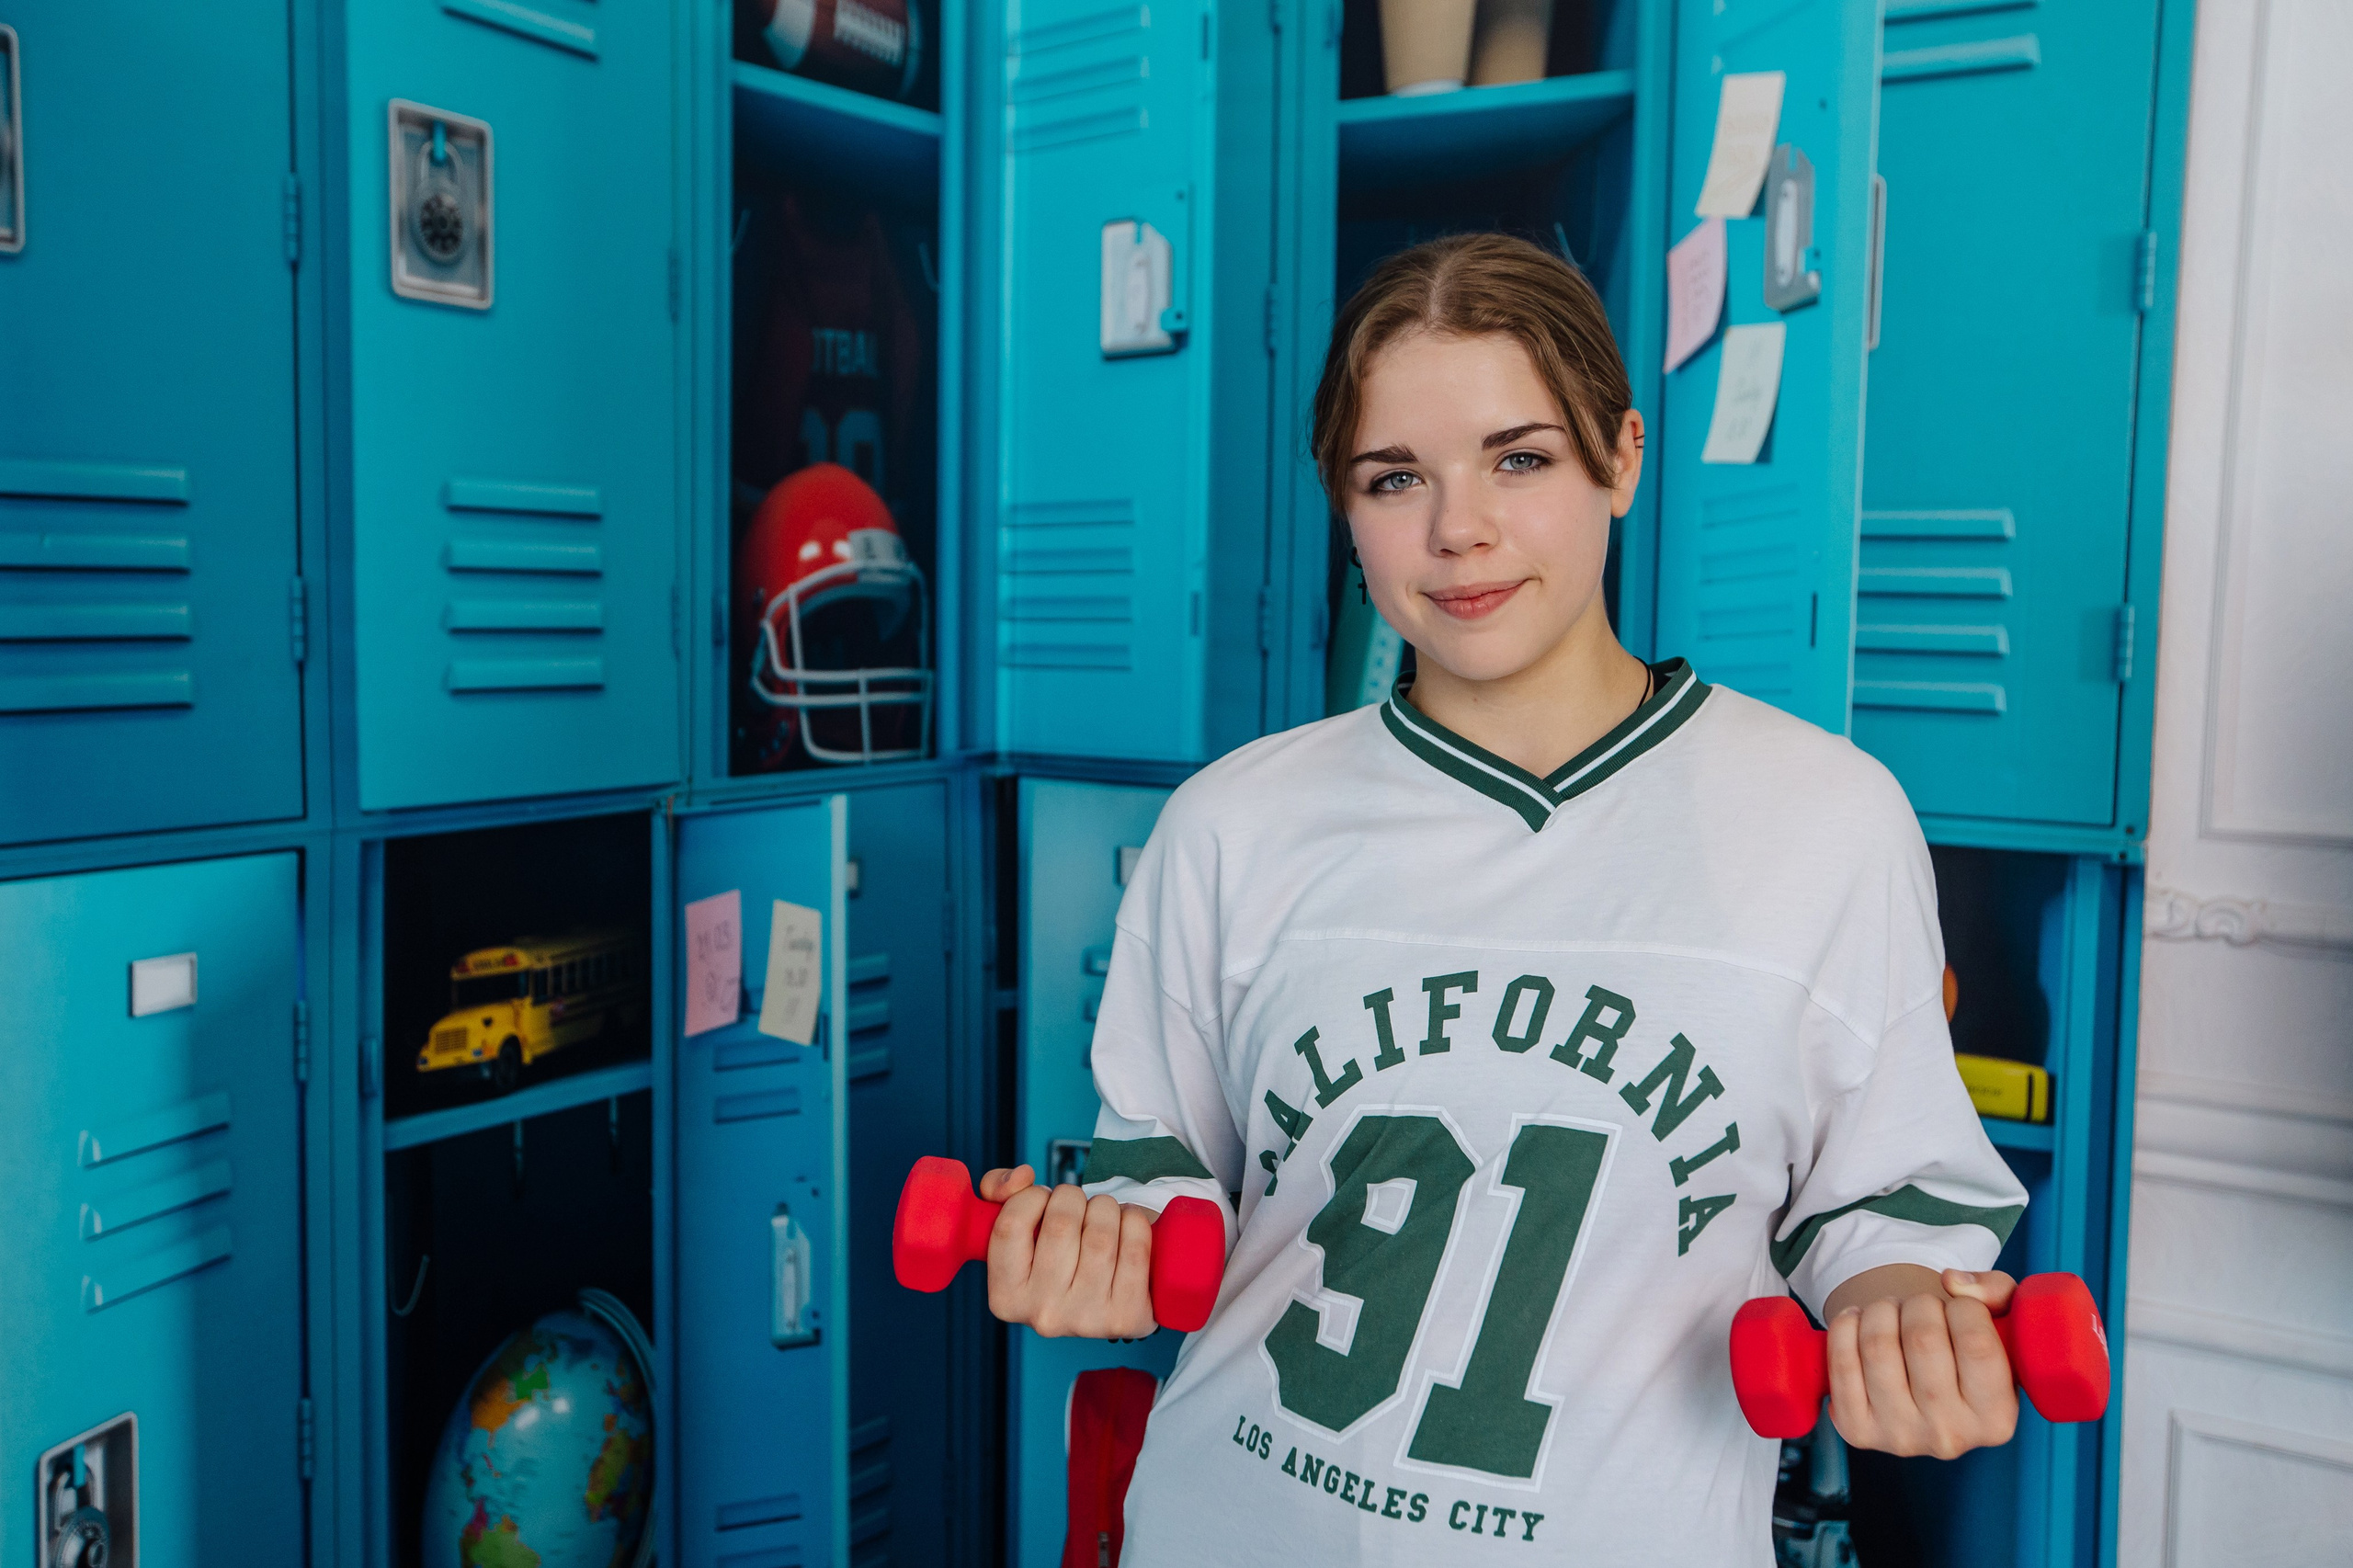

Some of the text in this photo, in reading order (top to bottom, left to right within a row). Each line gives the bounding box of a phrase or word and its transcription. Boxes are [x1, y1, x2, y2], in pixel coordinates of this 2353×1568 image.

[1258, 1104, 1623, 1494] 91
[1233, 1415, 1545, 1541] LOS ANGELES CITY
